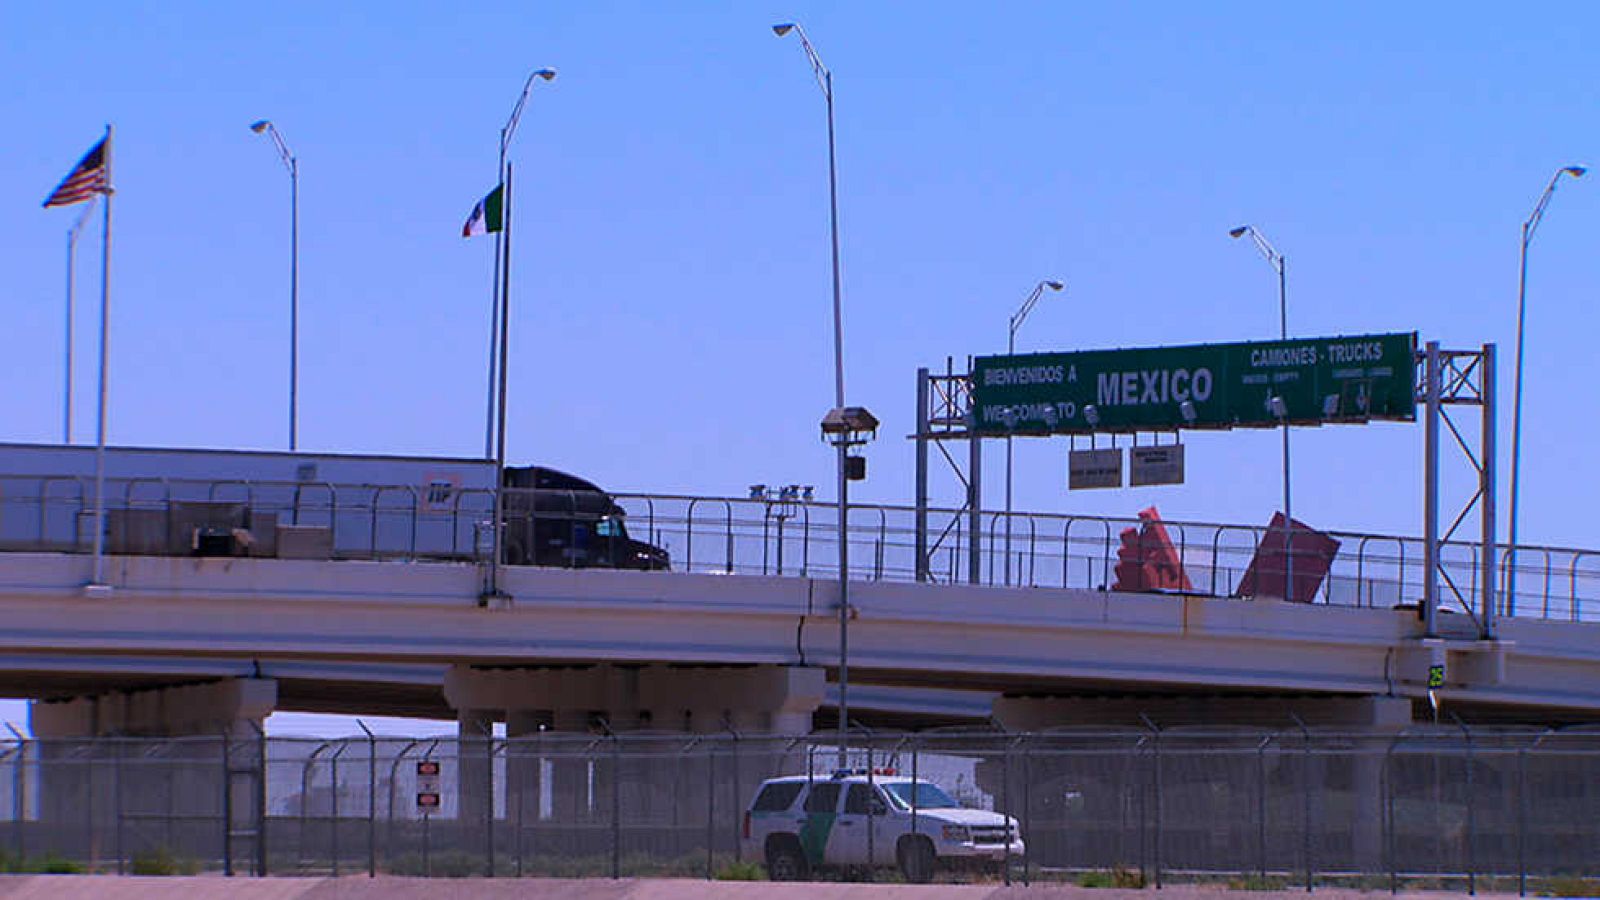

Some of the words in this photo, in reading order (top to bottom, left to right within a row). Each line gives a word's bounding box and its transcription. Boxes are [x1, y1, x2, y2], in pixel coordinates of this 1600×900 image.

[1251, 346, 1317, 367] CAMIONES
[1328, 341, 1383, 363] TRUCKS
[984, 365, 1064, 386] BIENVENIDOS
[1068, 364, 1077, 383] A
[1097, 367, 1213, 406] MEXICO
[1057, 402, 1075, 419] TO
